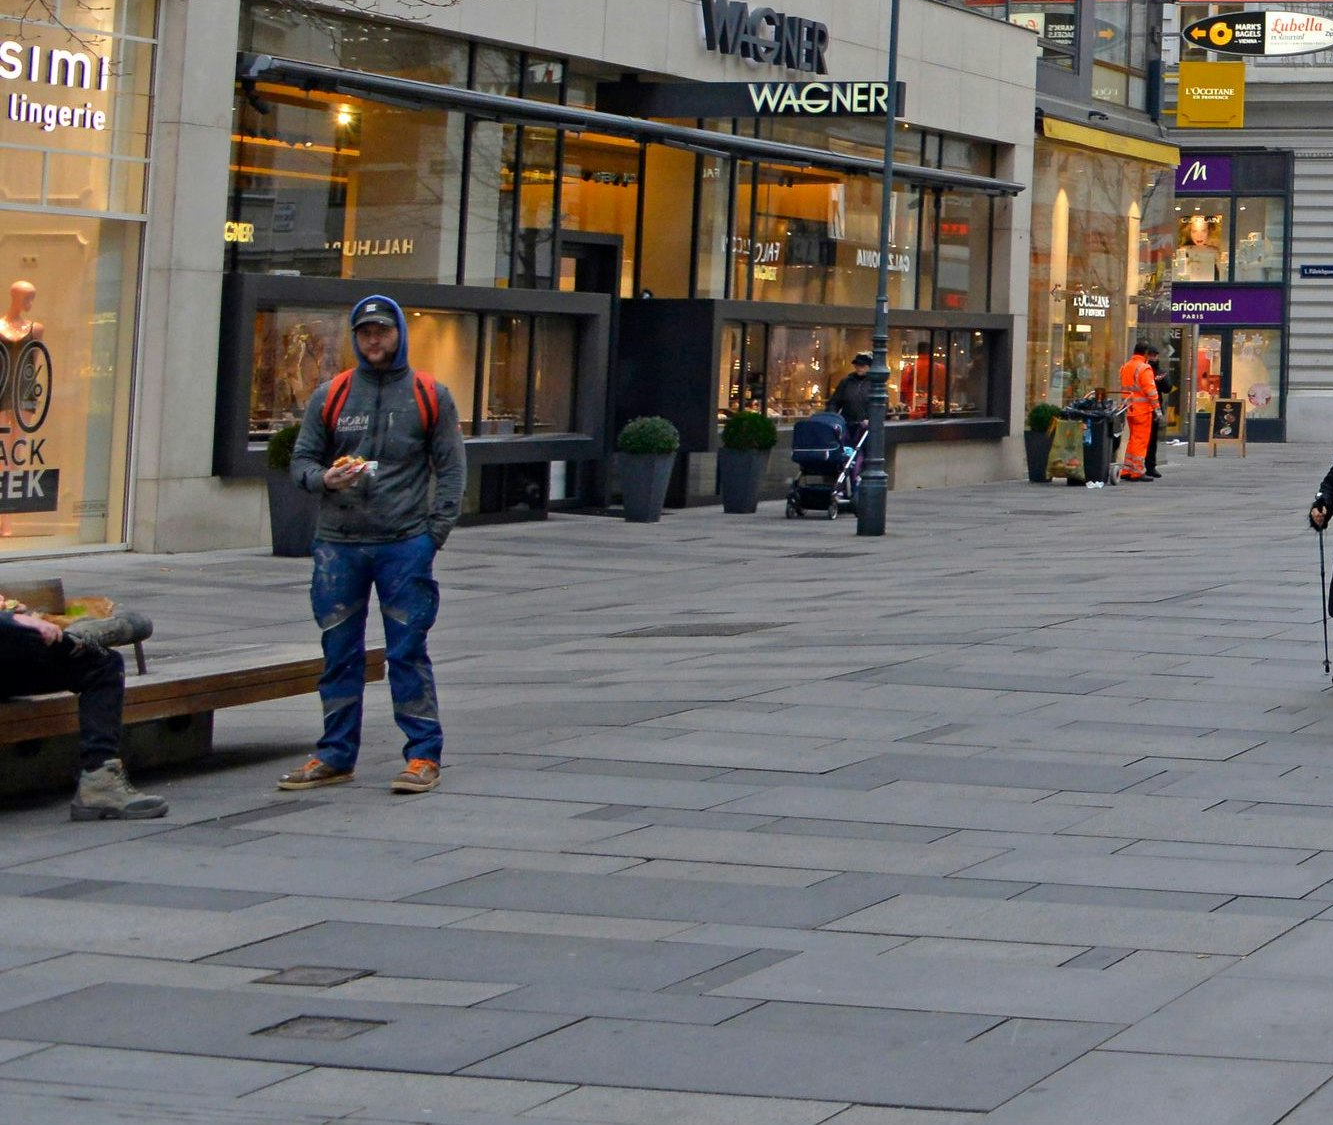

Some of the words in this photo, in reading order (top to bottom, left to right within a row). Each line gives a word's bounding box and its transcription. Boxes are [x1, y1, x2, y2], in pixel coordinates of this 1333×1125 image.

[1235, 23, 1262, 31] MARK'S
[1271, 17, 1323, 34] Lubella
[1235, 30, 1262, 38] BAGELS
[749, 82, 889, 114] WAGNER
[8, 93, 106, 132] lingerie
[1170, 300, 1232, 312] arionnaud
